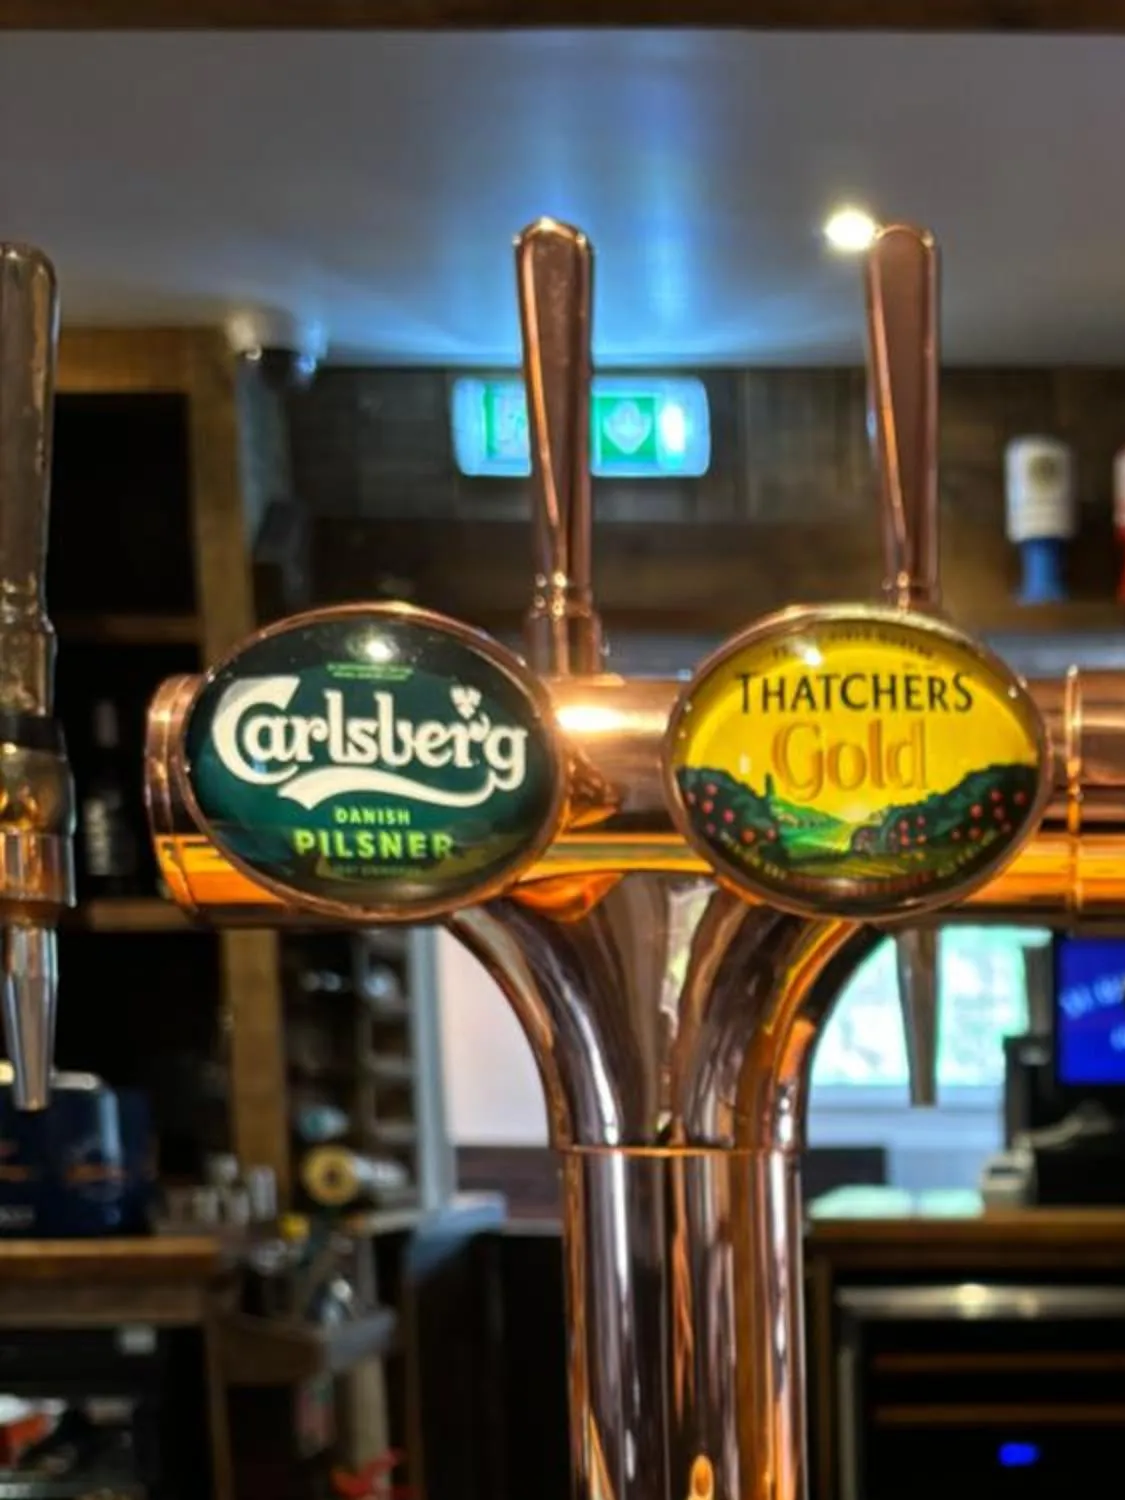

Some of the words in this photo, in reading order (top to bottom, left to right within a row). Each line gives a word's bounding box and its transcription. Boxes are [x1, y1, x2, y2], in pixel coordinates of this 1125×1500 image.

[736, 672, 974, 714] THATCHERS
[212, 675, 529, 792] Carlsberg
[771, 719, 928, 801] Gold
[333, 806, 411, 826] DANISH
[294, 829, 455, 860] PILSNER
